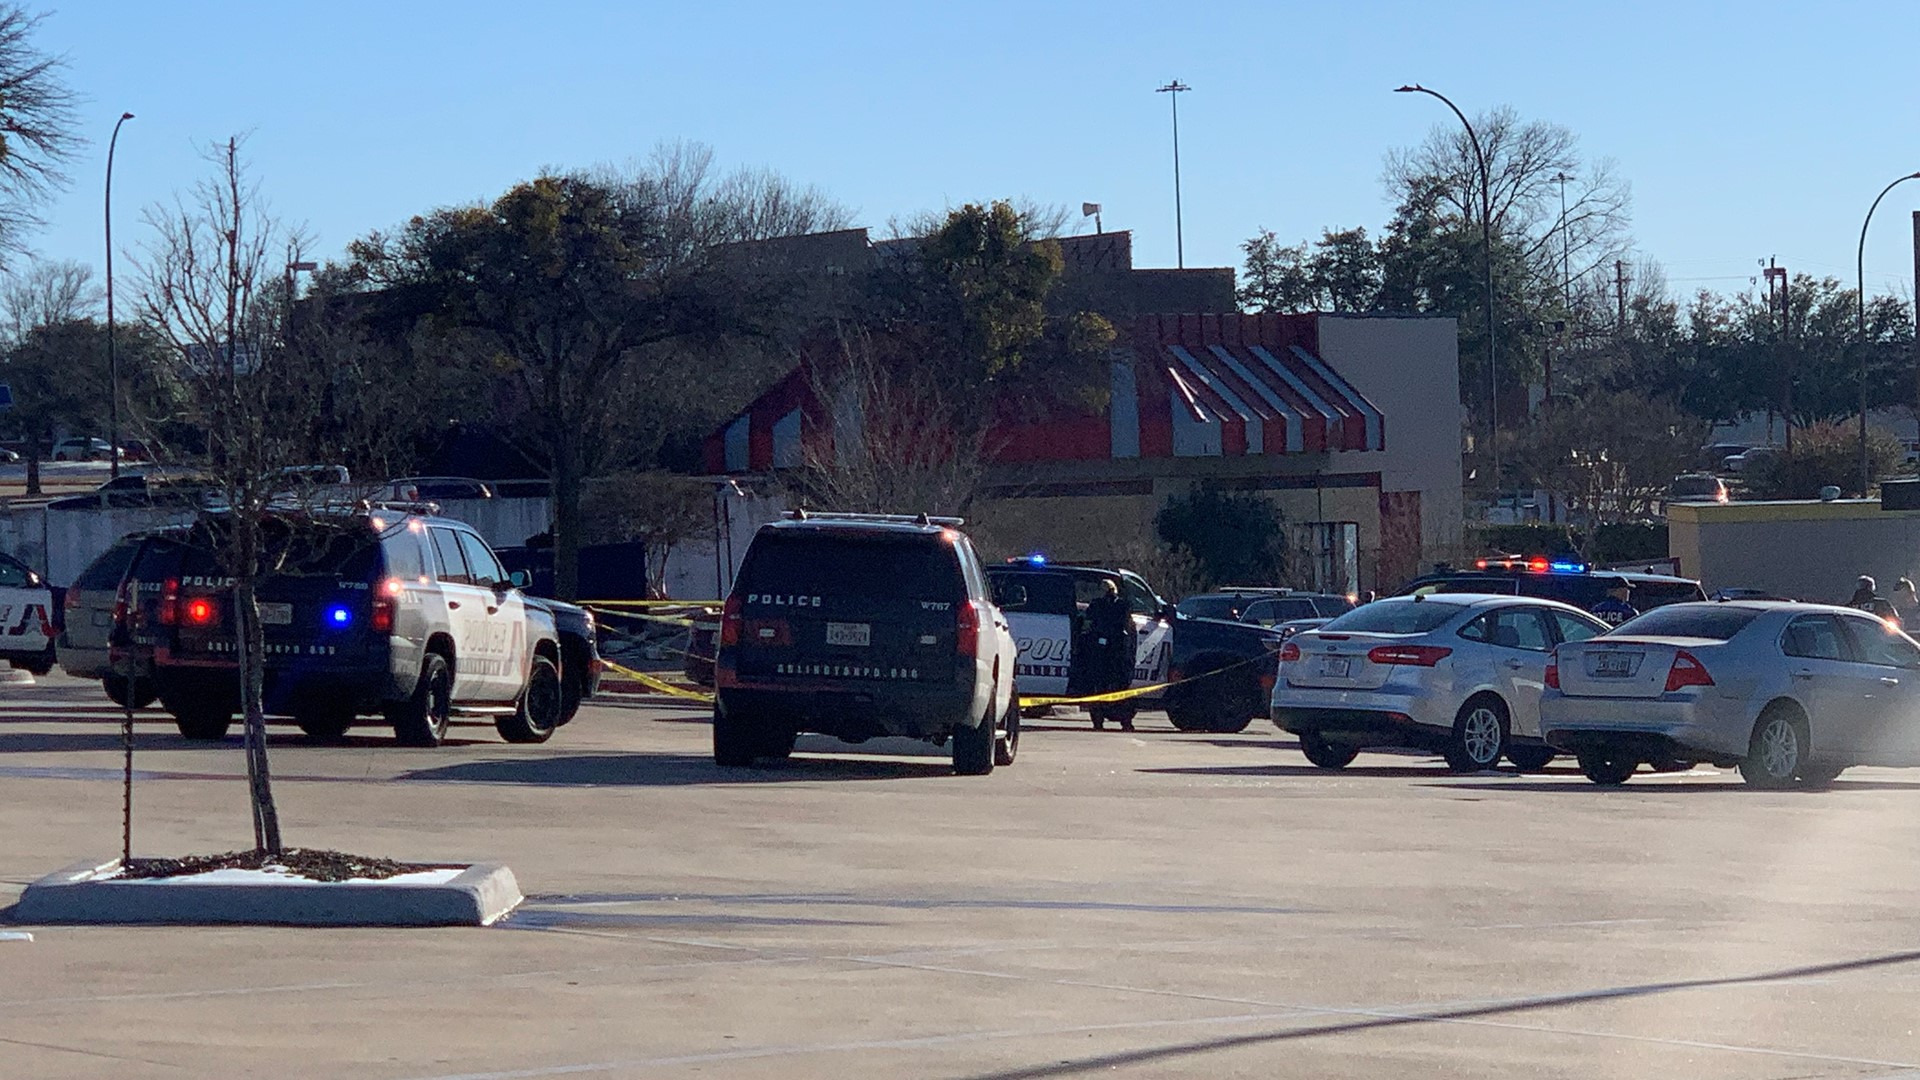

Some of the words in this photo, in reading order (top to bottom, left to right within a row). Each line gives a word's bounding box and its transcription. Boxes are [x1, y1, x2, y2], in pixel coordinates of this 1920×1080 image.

[182, 576, 236, 587] POLIC
[748, 594, 821, 607] POLICE
[921, 601, 951, 611] W767
[777, 664, 919, 679] ARLINGTONPD.ORG
